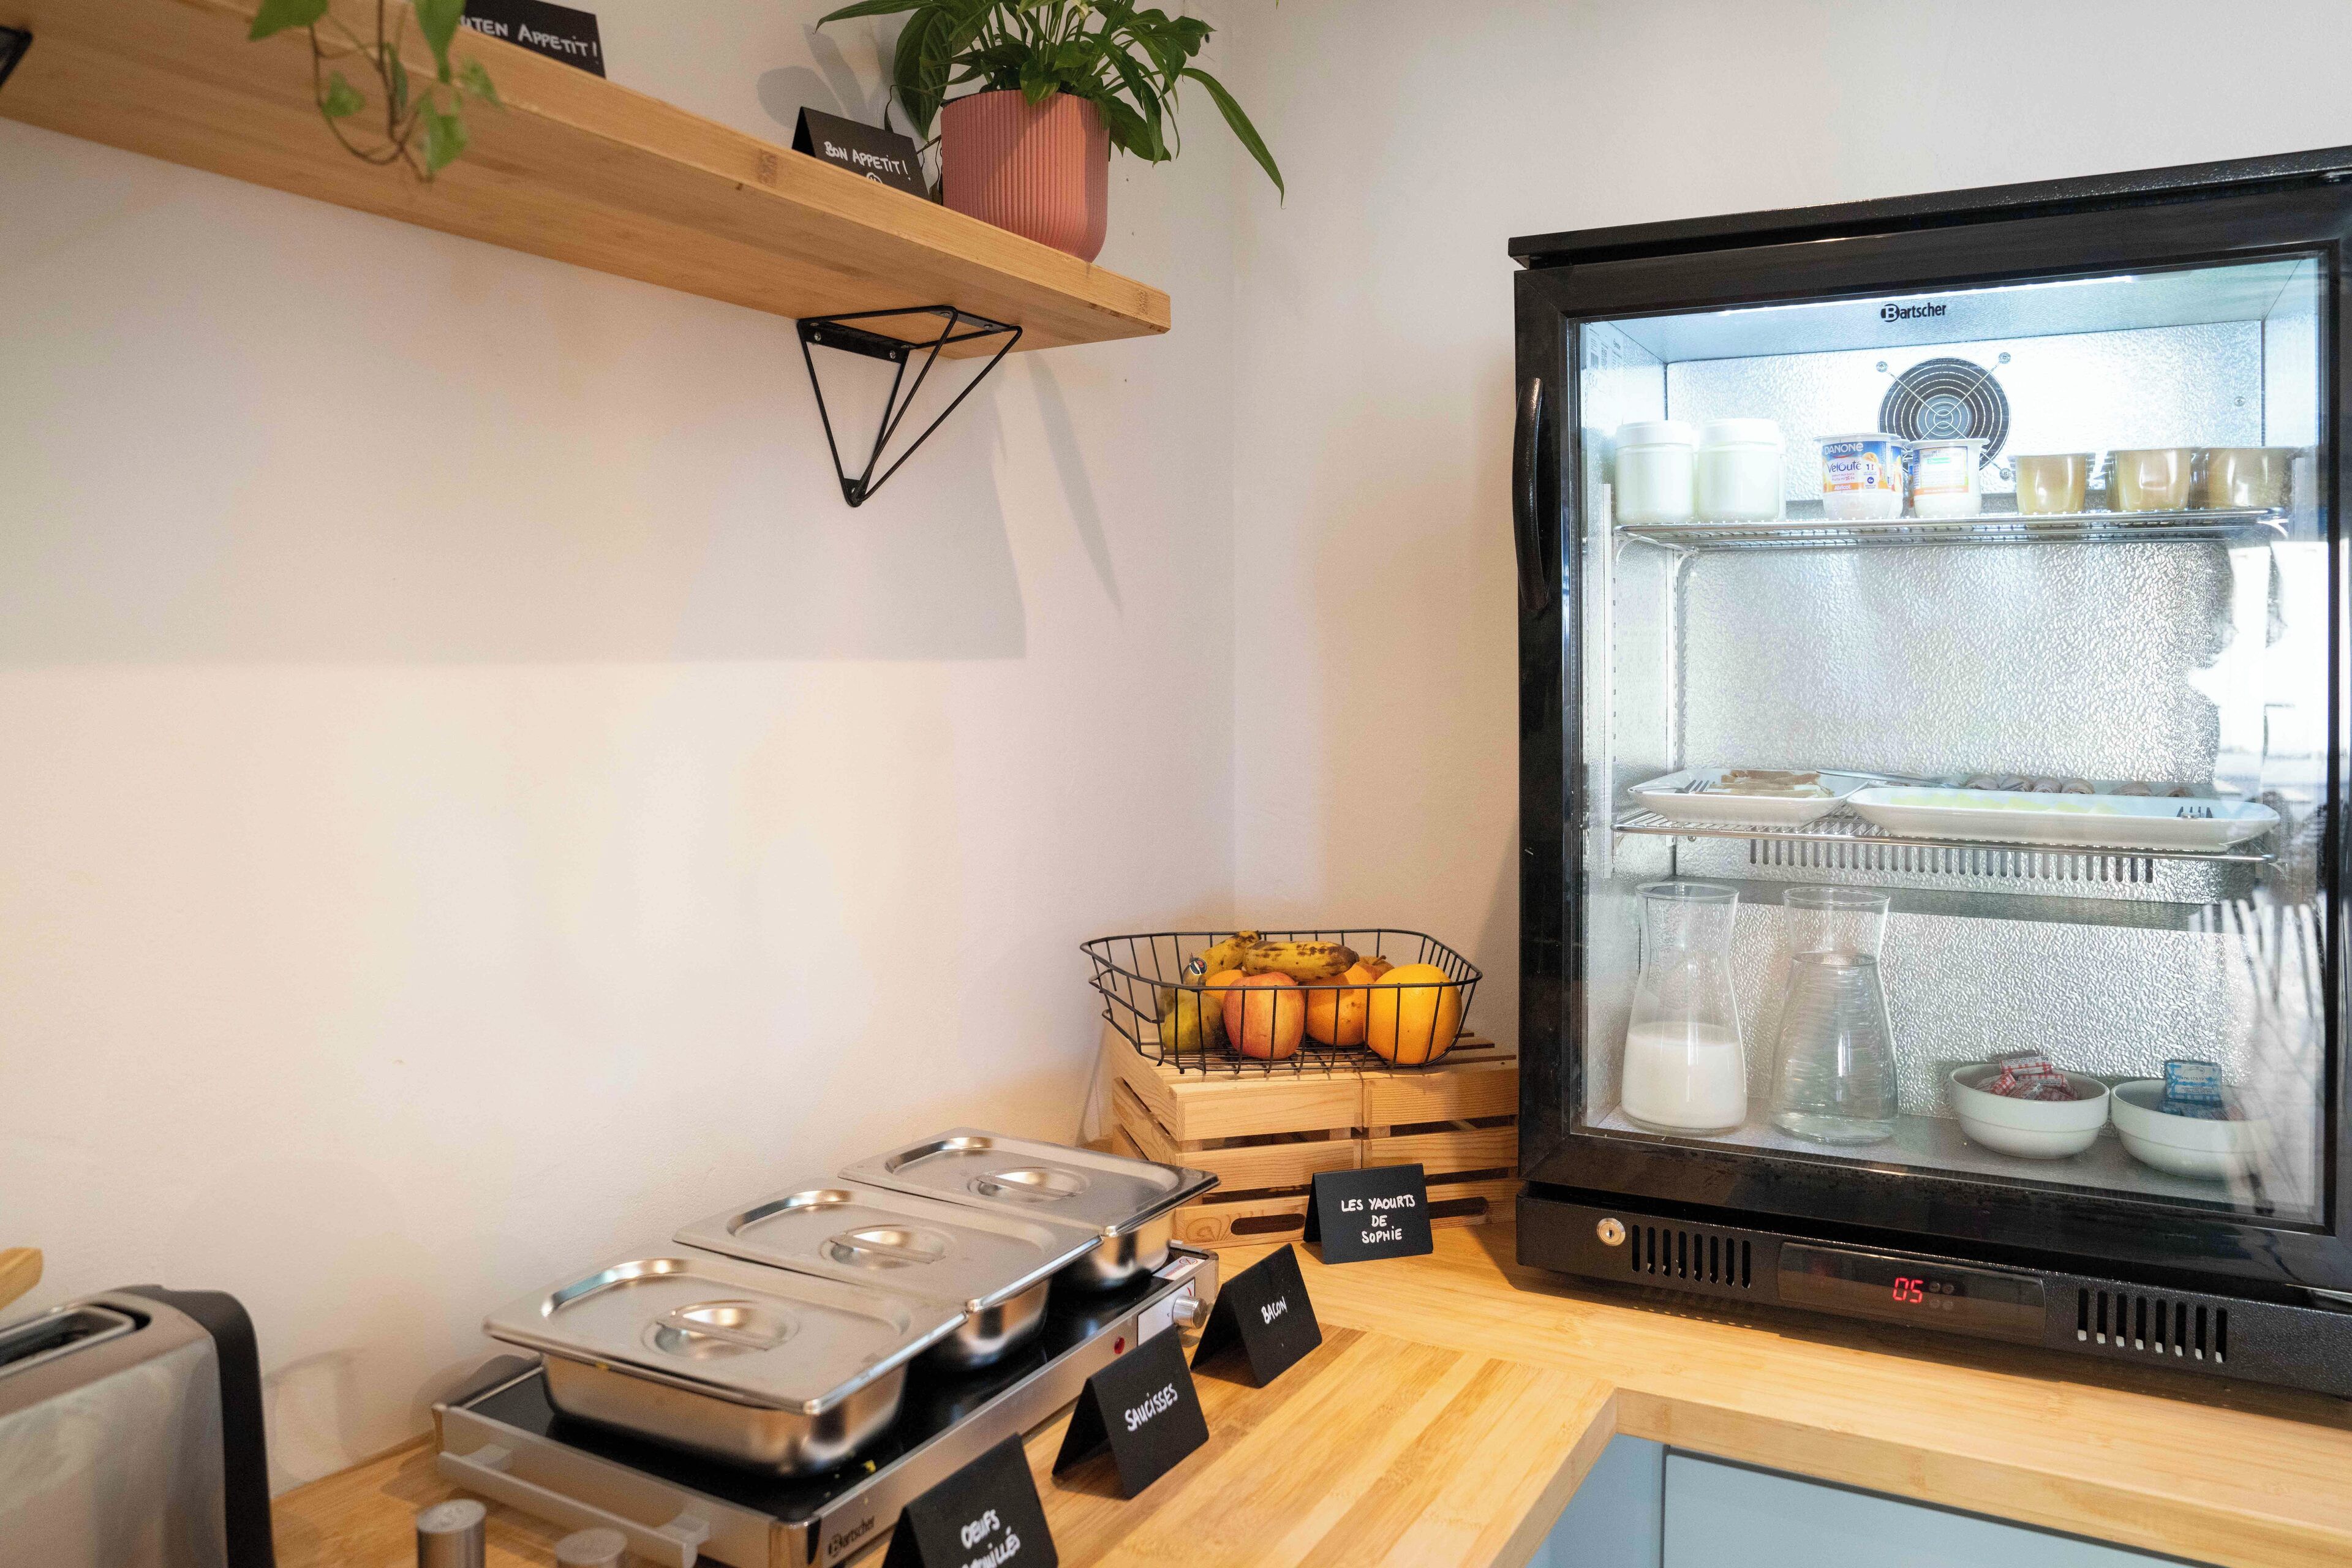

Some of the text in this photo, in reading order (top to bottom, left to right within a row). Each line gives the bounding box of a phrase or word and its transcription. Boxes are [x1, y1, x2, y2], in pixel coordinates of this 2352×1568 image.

[824, 141, 848, 160] BON
[1880, 303, 1946, 323] Bartscher
[1341, 1194, 1415, 1212] LES YAOURTS
[1371, 1215, 1387, 1227] DE
[1893, 1278, 1923, 1303] 05
[1261, 1296, 1287, 1324] BACON
